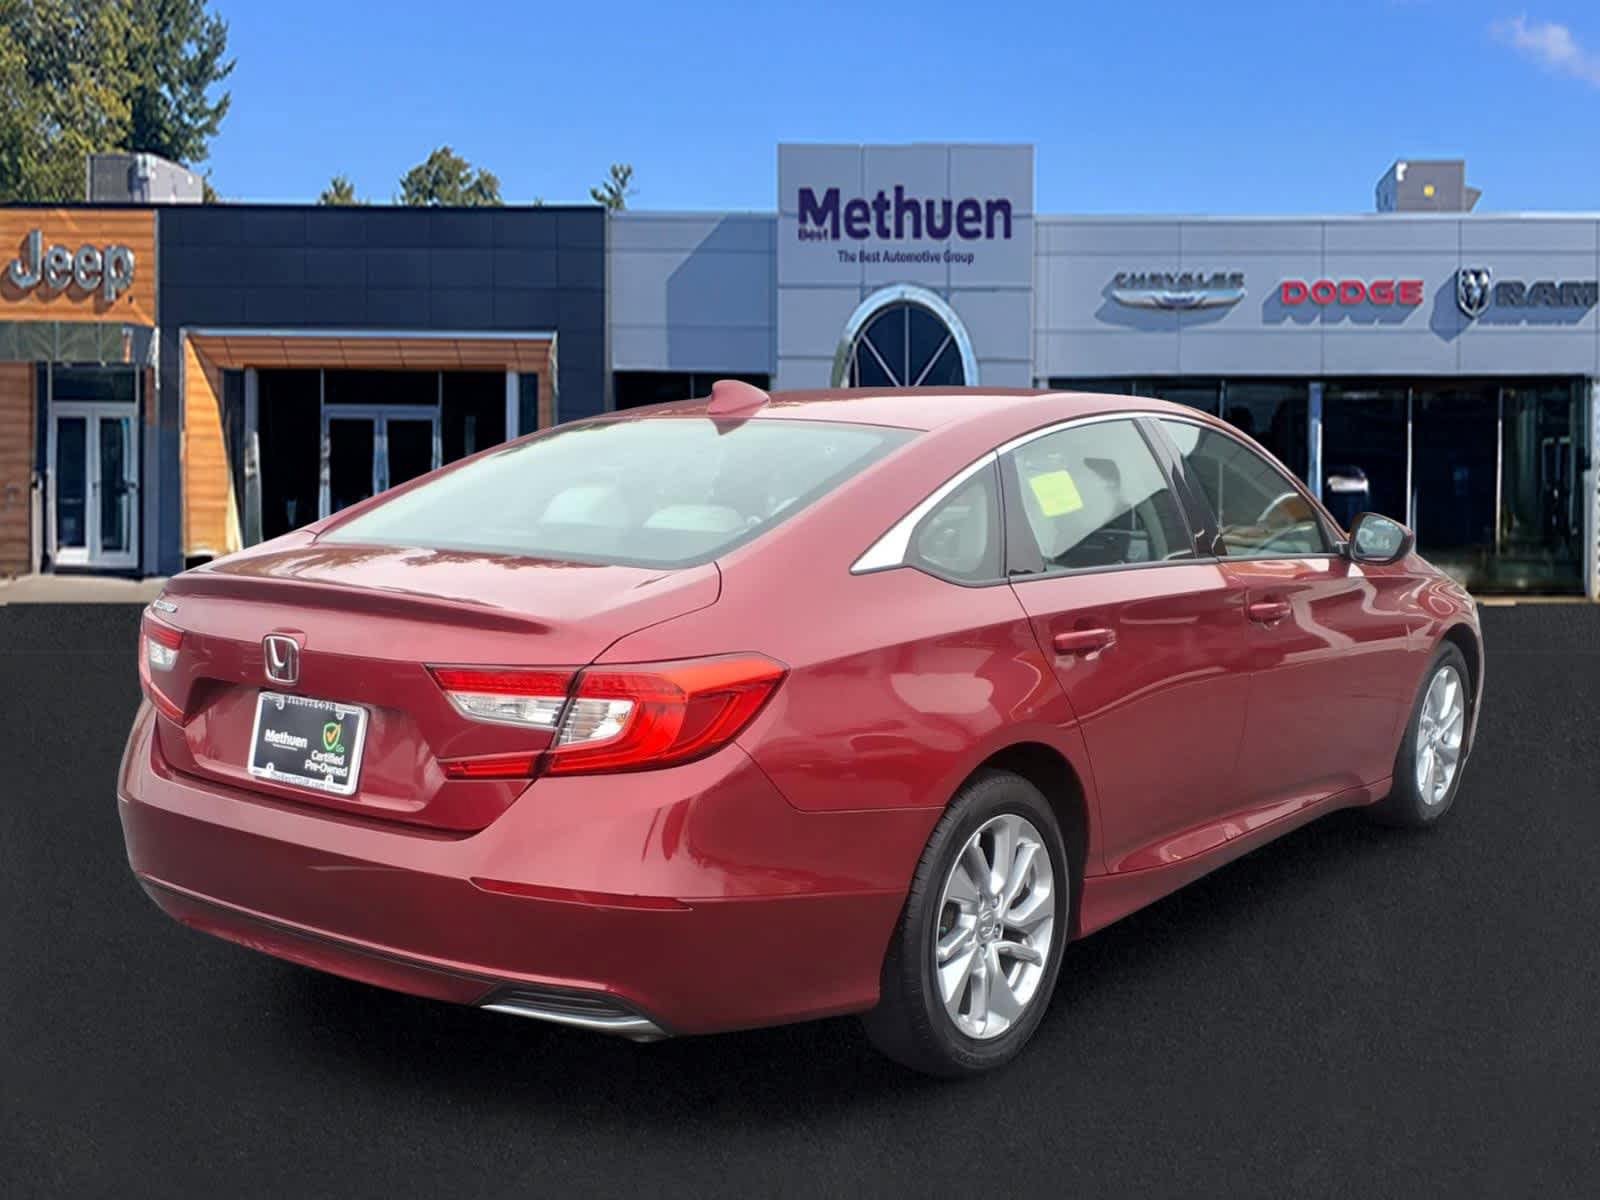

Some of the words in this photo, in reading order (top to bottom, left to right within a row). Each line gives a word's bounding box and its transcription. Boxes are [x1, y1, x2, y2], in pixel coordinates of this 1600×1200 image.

[798, 185, 1012, 240] Methuen
[798, 228, 828, 241] Best
[9, 229, 135, 301] Jeep
[837, 249, 857, 263] The
[859, 249, 881, 263] Best
[882, 249, 941, 263] Automotive
[943, 249, 975, 265] Group
[1113, 271, 1245, 289] CHRYSLER
[1281, 279, 1424, 305] DODGE
[1496, 281, 1598, 306] RAM
[264, 729, 308, 748] Methuen
